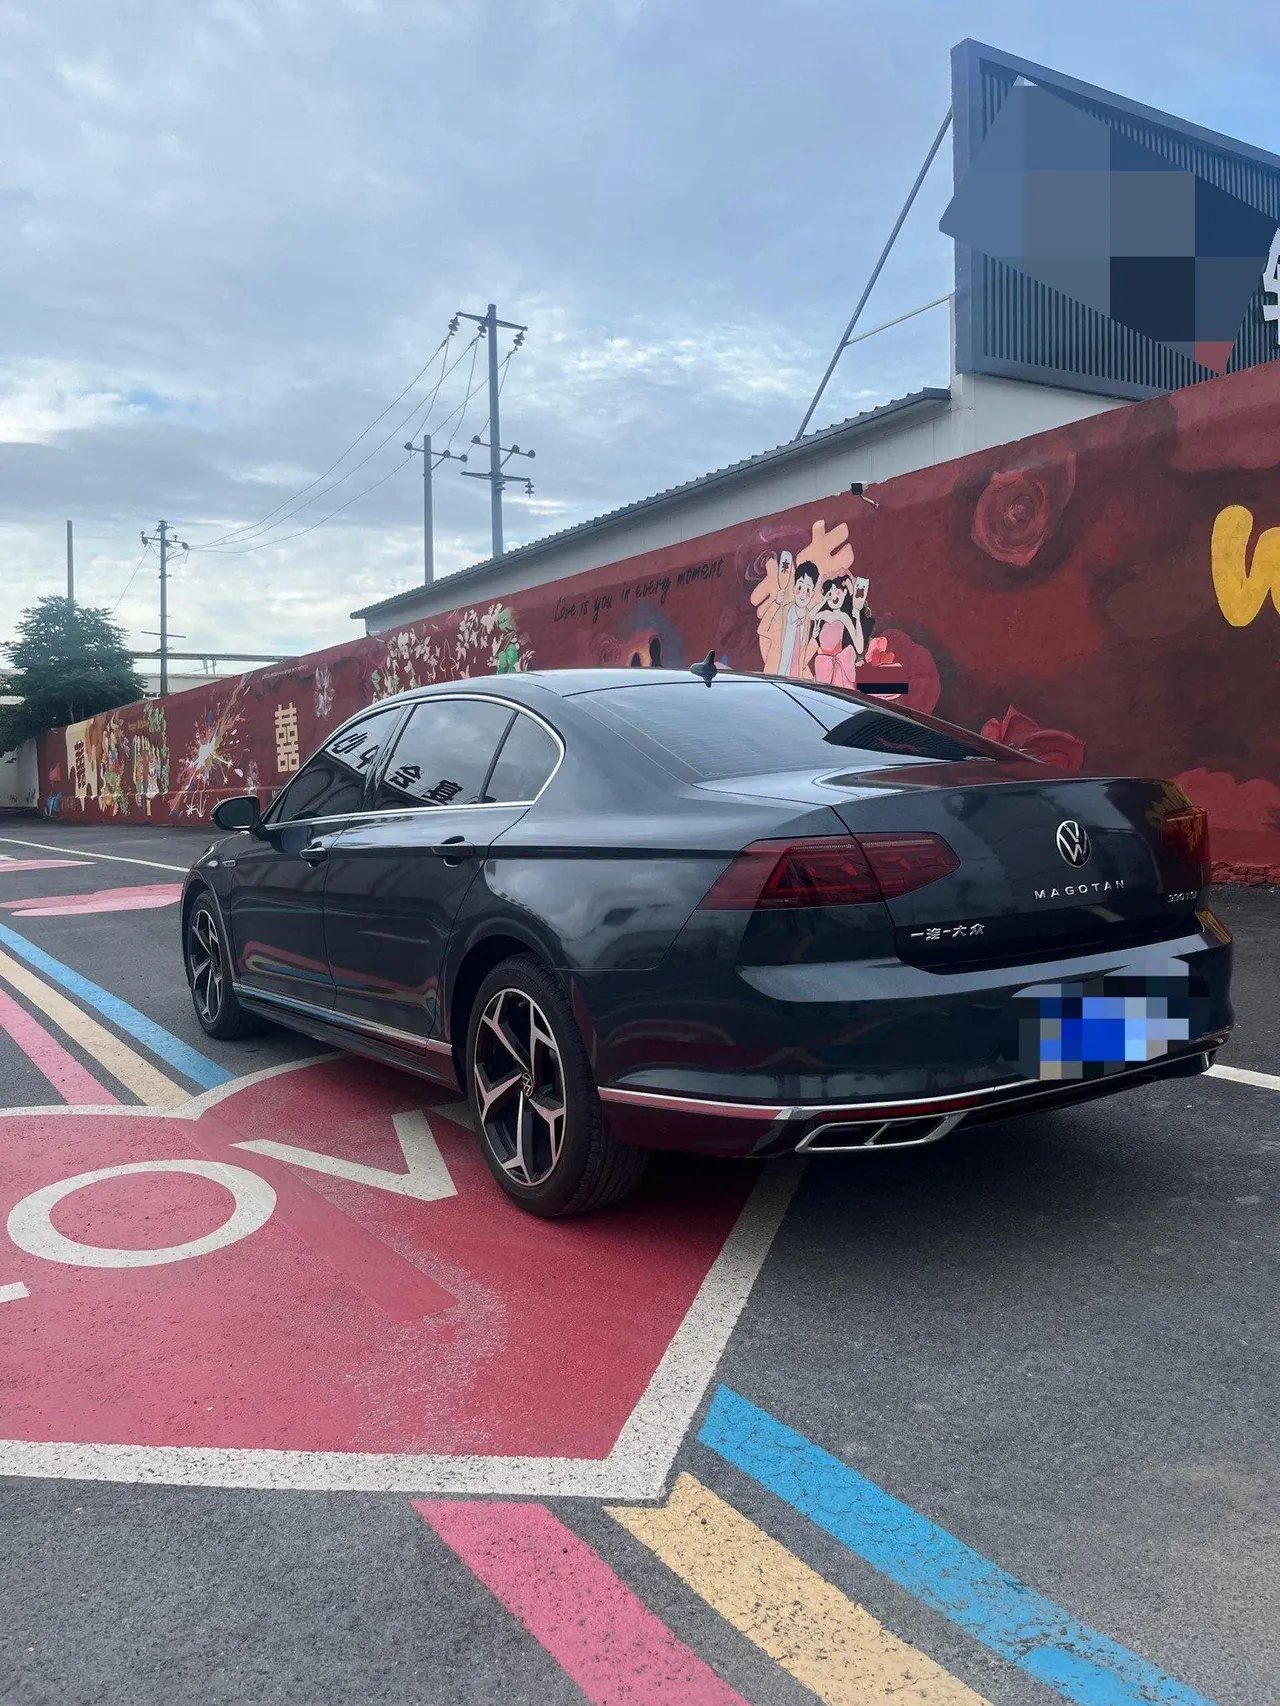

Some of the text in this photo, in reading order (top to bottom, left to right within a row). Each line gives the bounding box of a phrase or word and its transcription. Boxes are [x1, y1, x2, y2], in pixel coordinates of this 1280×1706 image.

[553, 558, 724, 624] Love is you in every moment
[1034, 879, 1126, 900] MAGOTAN
